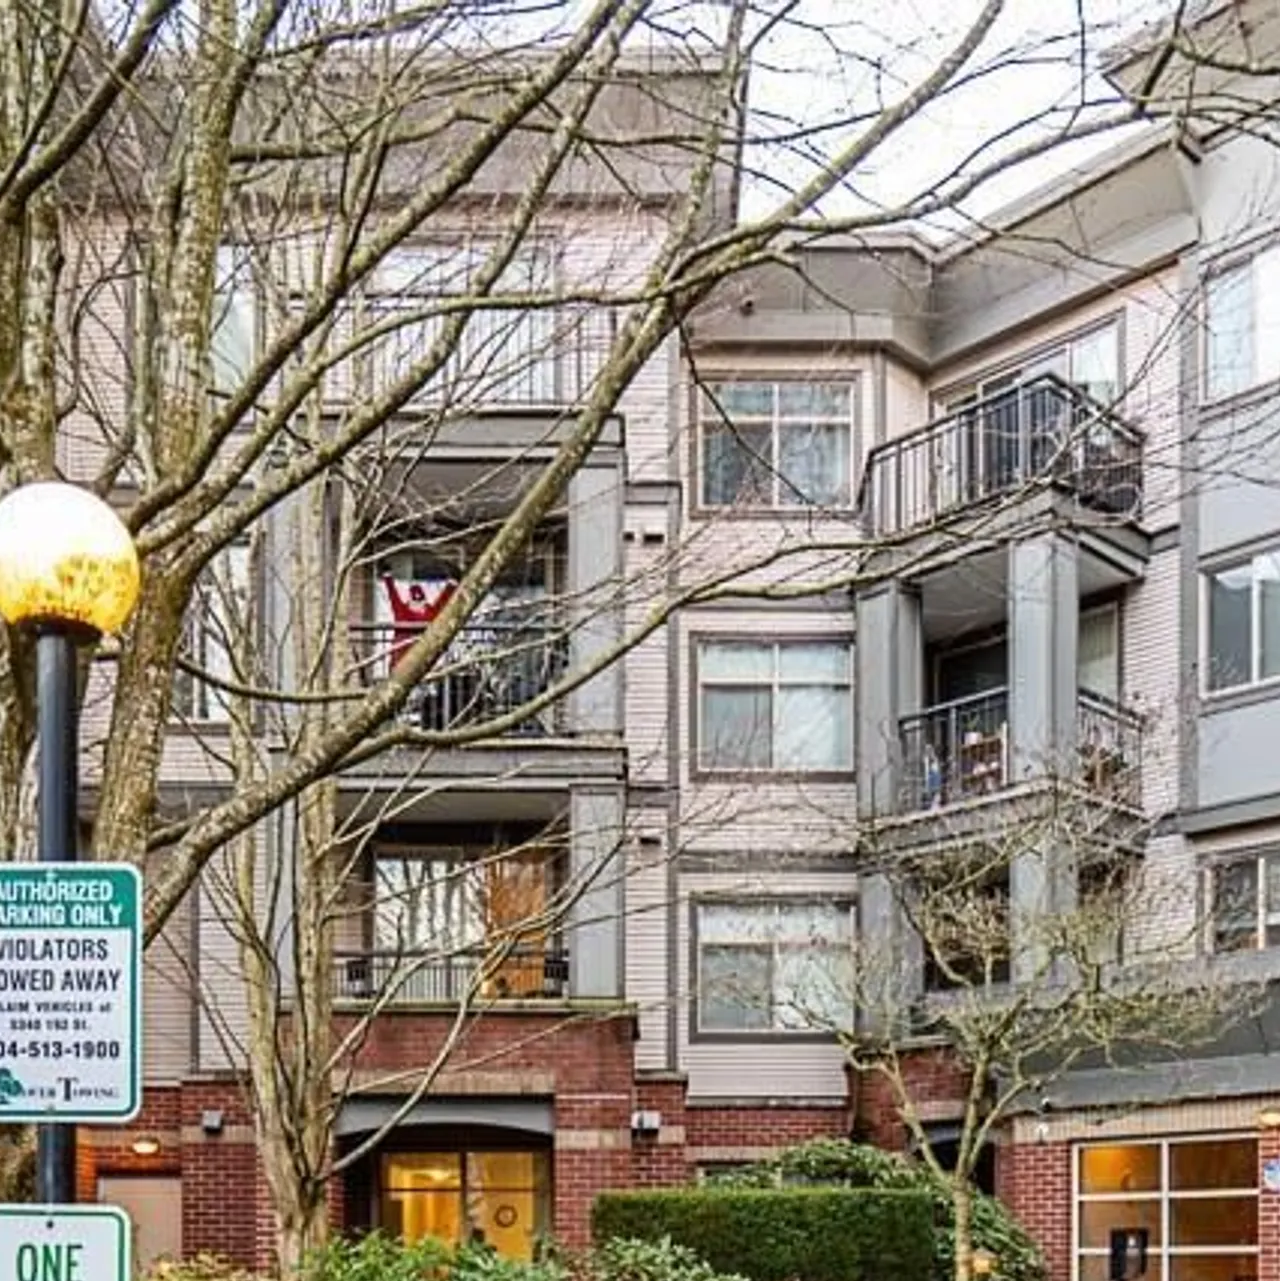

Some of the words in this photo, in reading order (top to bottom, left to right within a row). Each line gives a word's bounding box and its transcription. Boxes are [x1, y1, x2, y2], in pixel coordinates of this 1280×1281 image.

[71, 905, 122, 925] ONLY
[60, 969, 121, 991] AWAY
[35, 1001, 92, 1013] VEHICLES
